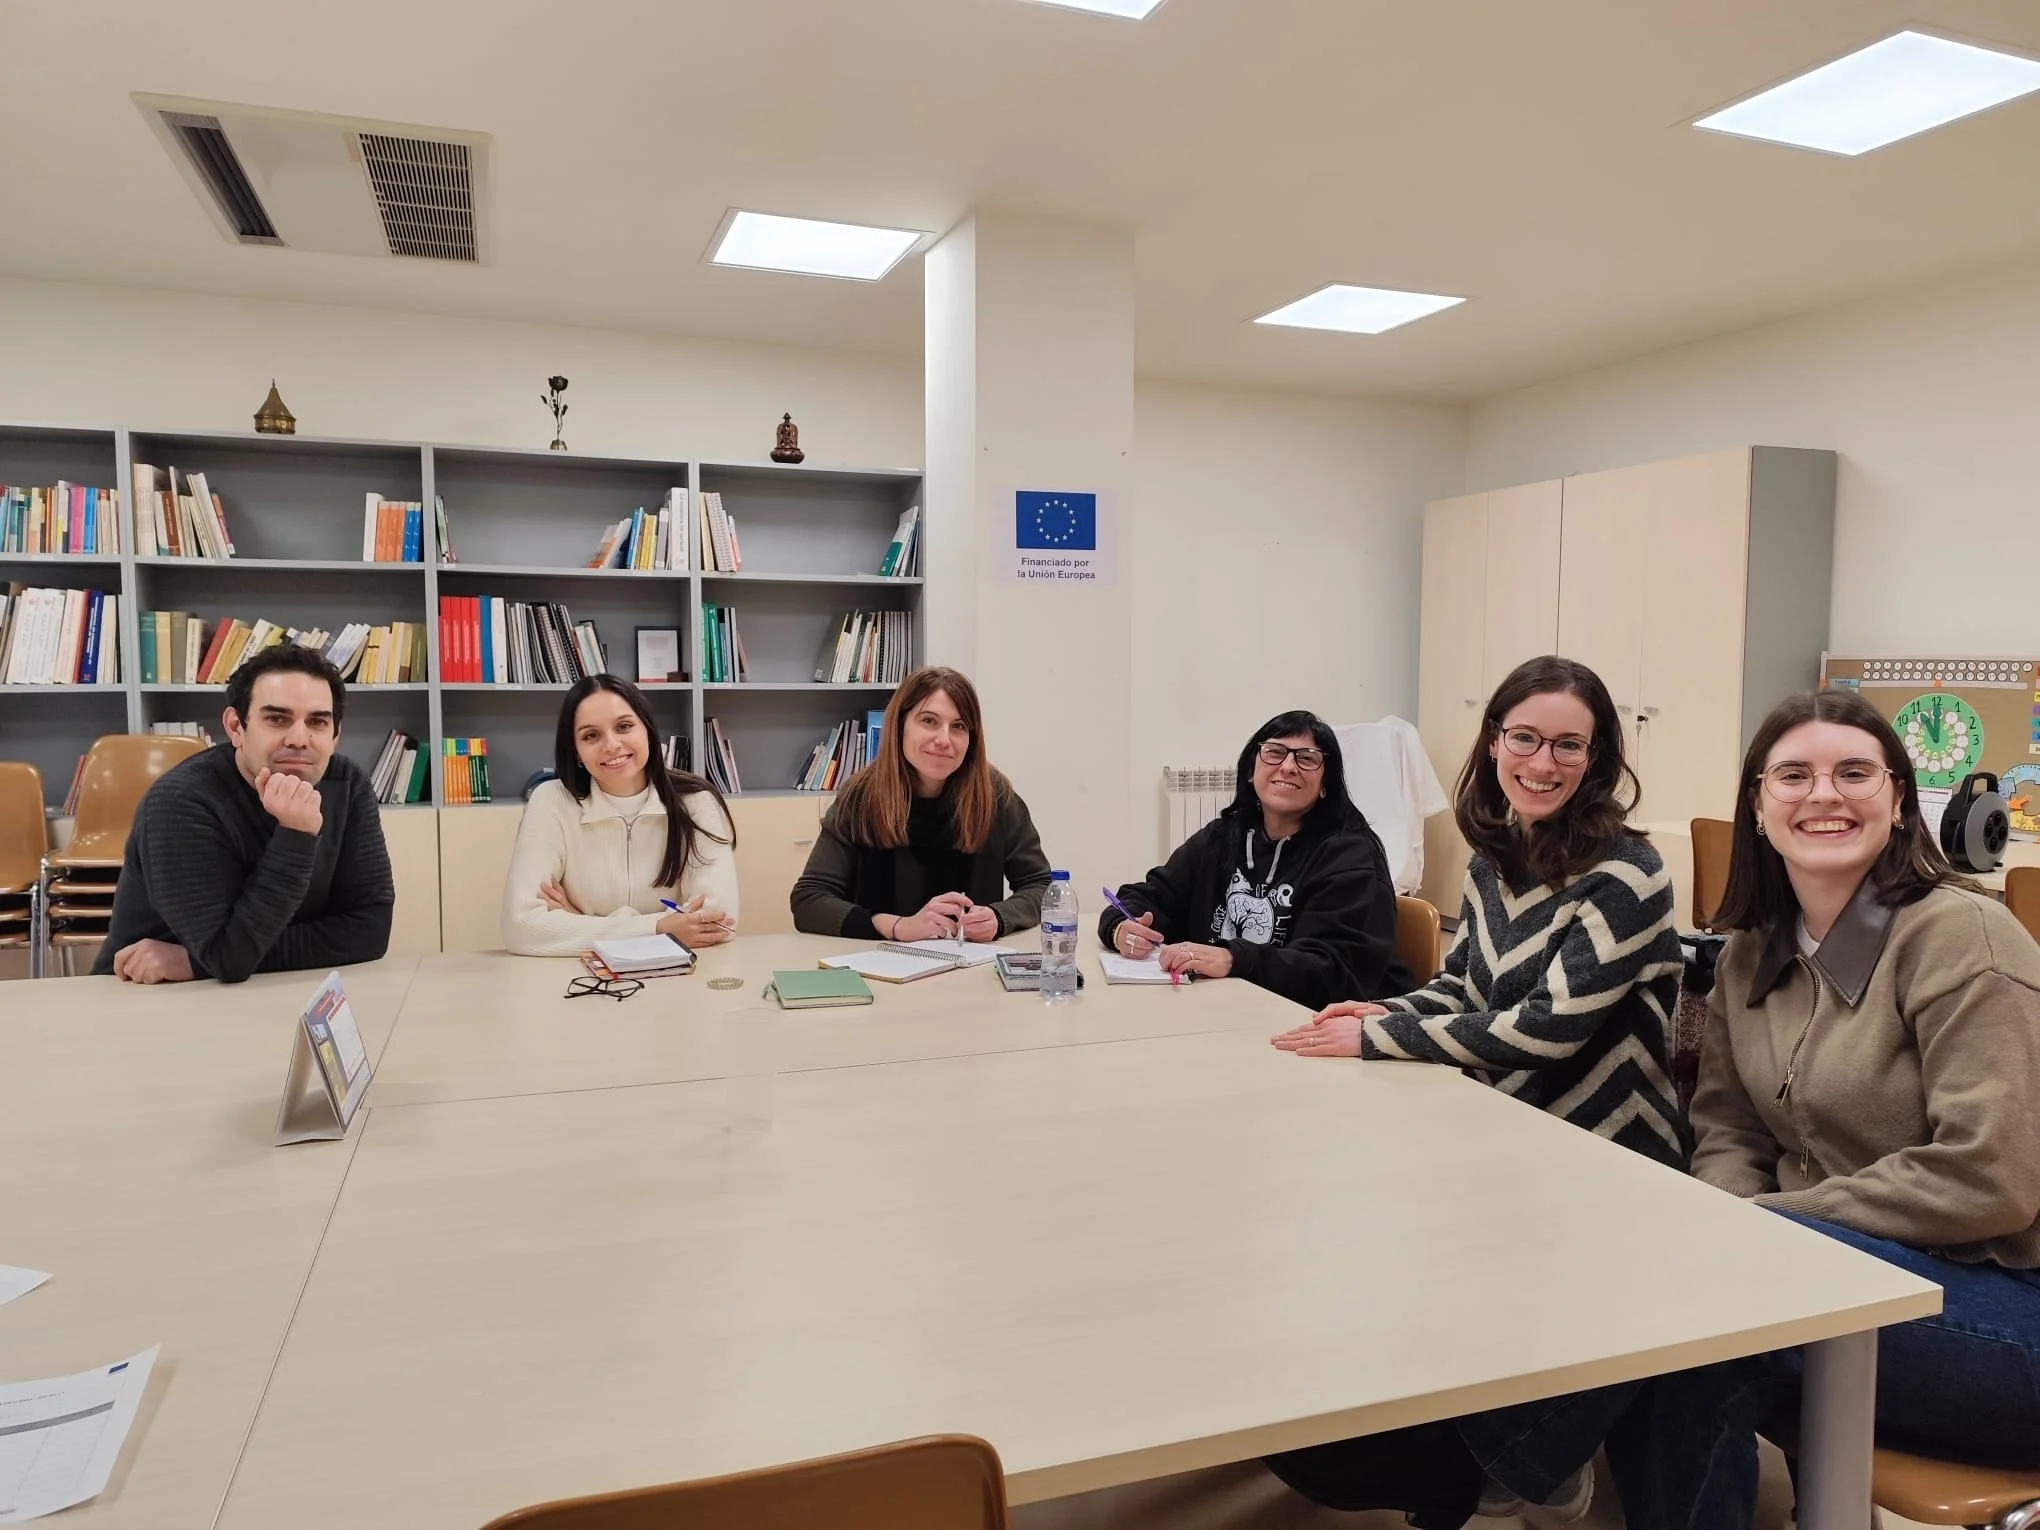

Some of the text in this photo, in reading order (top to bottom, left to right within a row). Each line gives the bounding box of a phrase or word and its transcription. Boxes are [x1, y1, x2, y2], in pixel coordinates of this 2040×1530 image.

[1021, 557, 1089, 569] Financiado por
[1017, 569, 1096, 580] la Unión Europea
[1910, 700, 1921, 715] 11
[1931, 696, 1943, 707] 12
[1955, 701, 1961, 713] 1
[1896, 714, 1908, 727] 10
[1969, 716, 1977, 730] 2
[1972, 735, 1980, 745] 3
[1964, 755, 1974, 768] 4
[1928, 776, 1936, 785] 6
[1948, 772, 1956, 784] 5
[1270, 914, 1292, 947] LIFE
